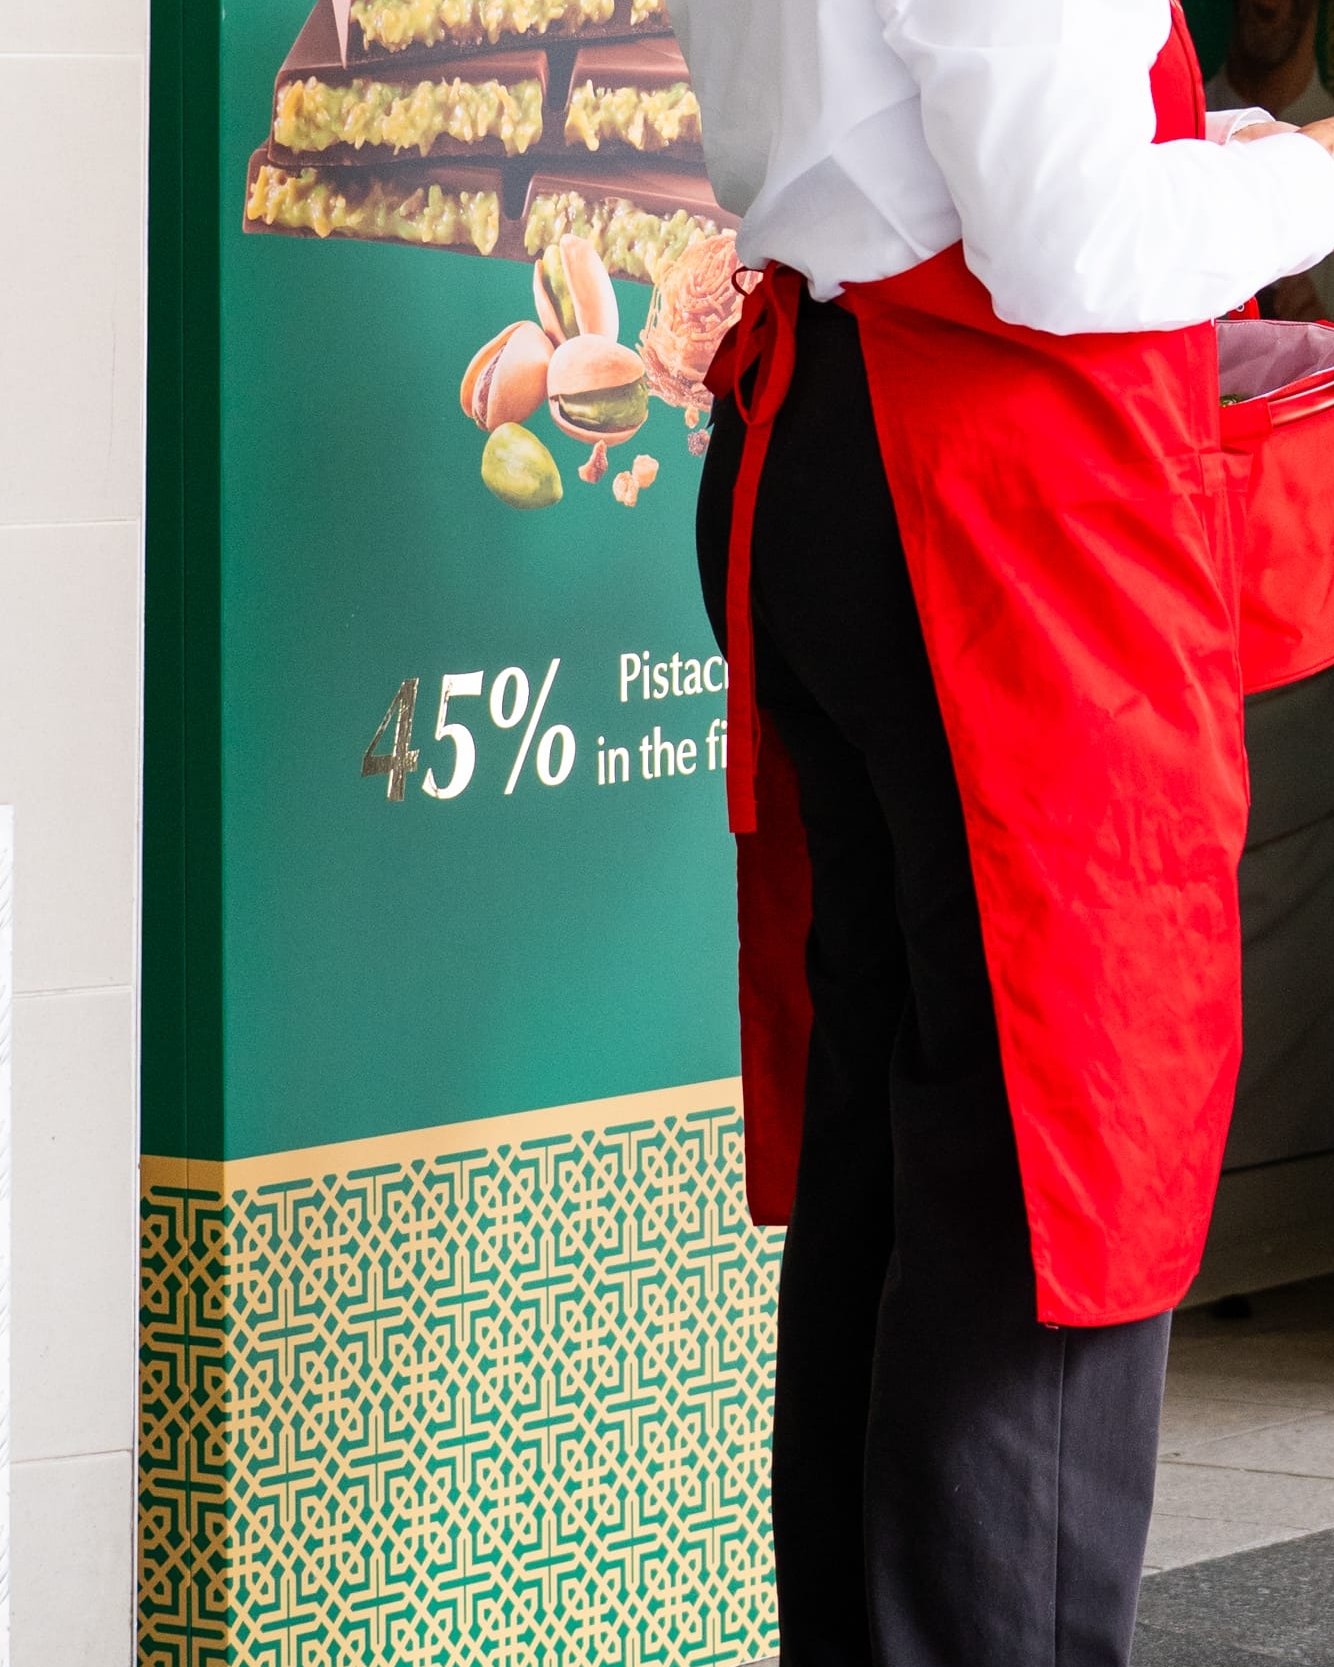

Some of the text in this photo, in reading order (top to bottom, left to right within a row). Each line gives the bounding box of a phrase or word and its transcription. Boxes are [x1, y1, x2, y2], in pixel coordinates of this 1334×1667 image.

[360, 649, 729, 802] 45% Pistac
[597, 735, 630, 786] in
[639, 725, 697, 781] the
